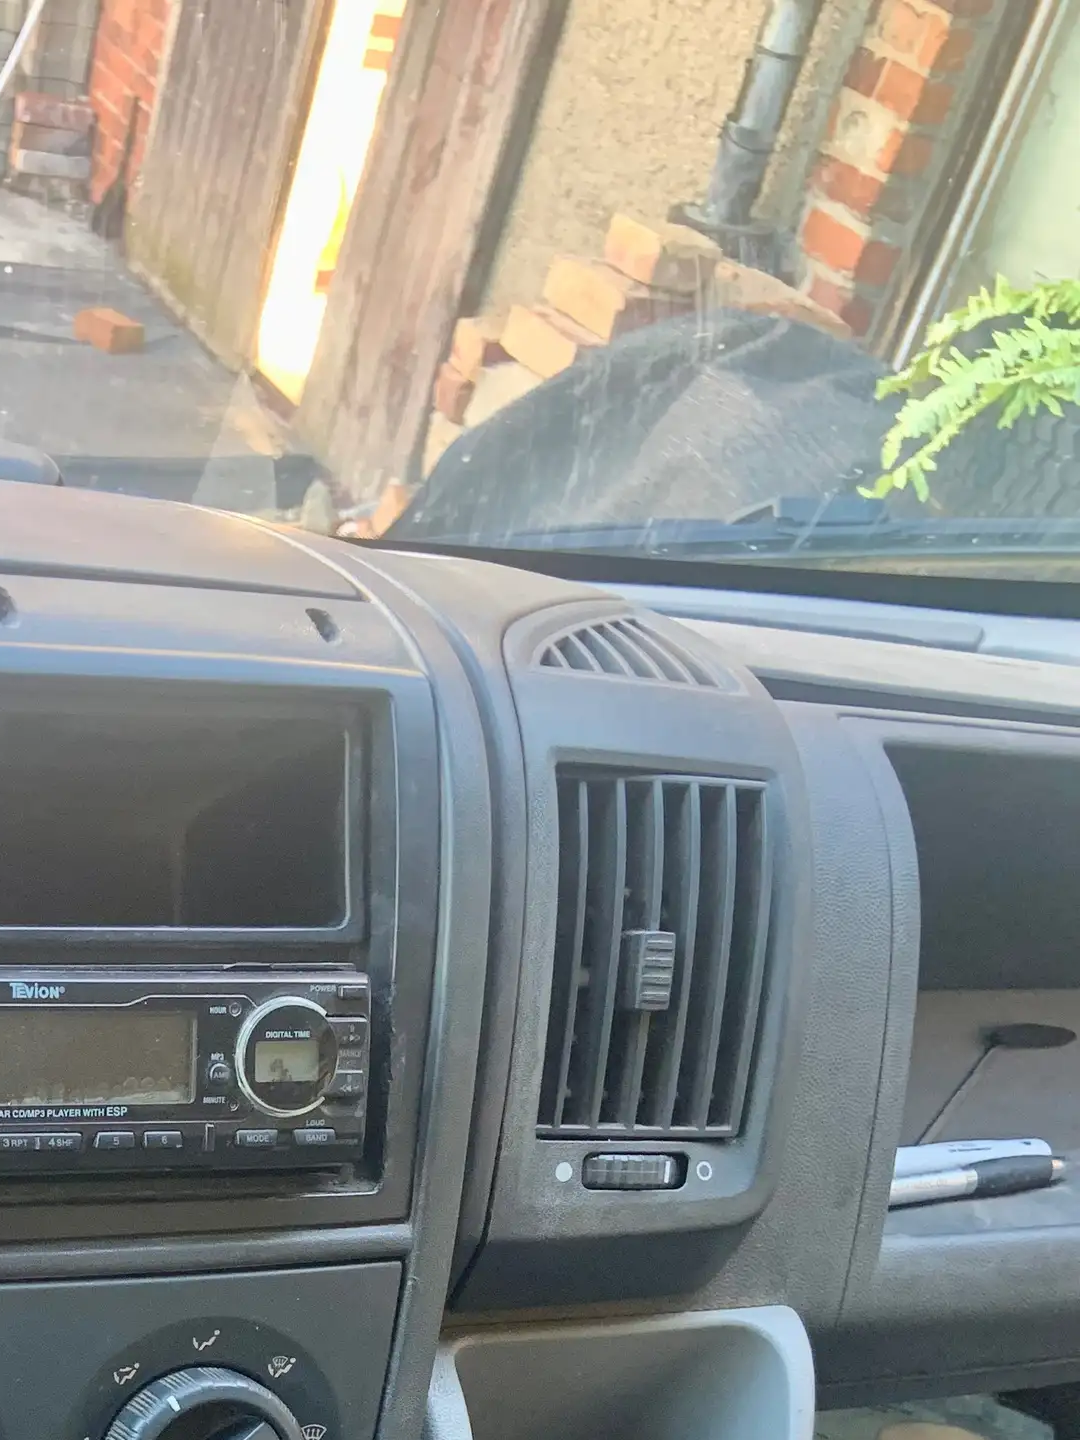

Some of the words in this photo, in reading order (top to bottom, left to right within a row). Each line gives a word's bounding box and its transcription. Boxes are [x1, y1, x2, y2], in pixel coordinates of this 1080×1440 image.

[309, 985, 337, 993] POWER
[265, 1031, 293, 1039] DIGITAL
[294, 1030, 311, 1038] TIME
[211, 1052, 224, 1061] MP3
[12, 1109, 46, 1118] CD/MP3
[46, 1108, 81, 1118] PLAYER
[82, 1107, 106, 1117] WITH
[106, 1106, 128, 1116] ESP
[3, 1138, 10, 1147] 3
[11, 1138, 28, 1147] RPT
[48, 1138, 56, 1147] 4
[113, 1136, 120, 1146] 5
[161, 1135, 168, 1145] 6
[246, 1134, 270, 1143] MODE
